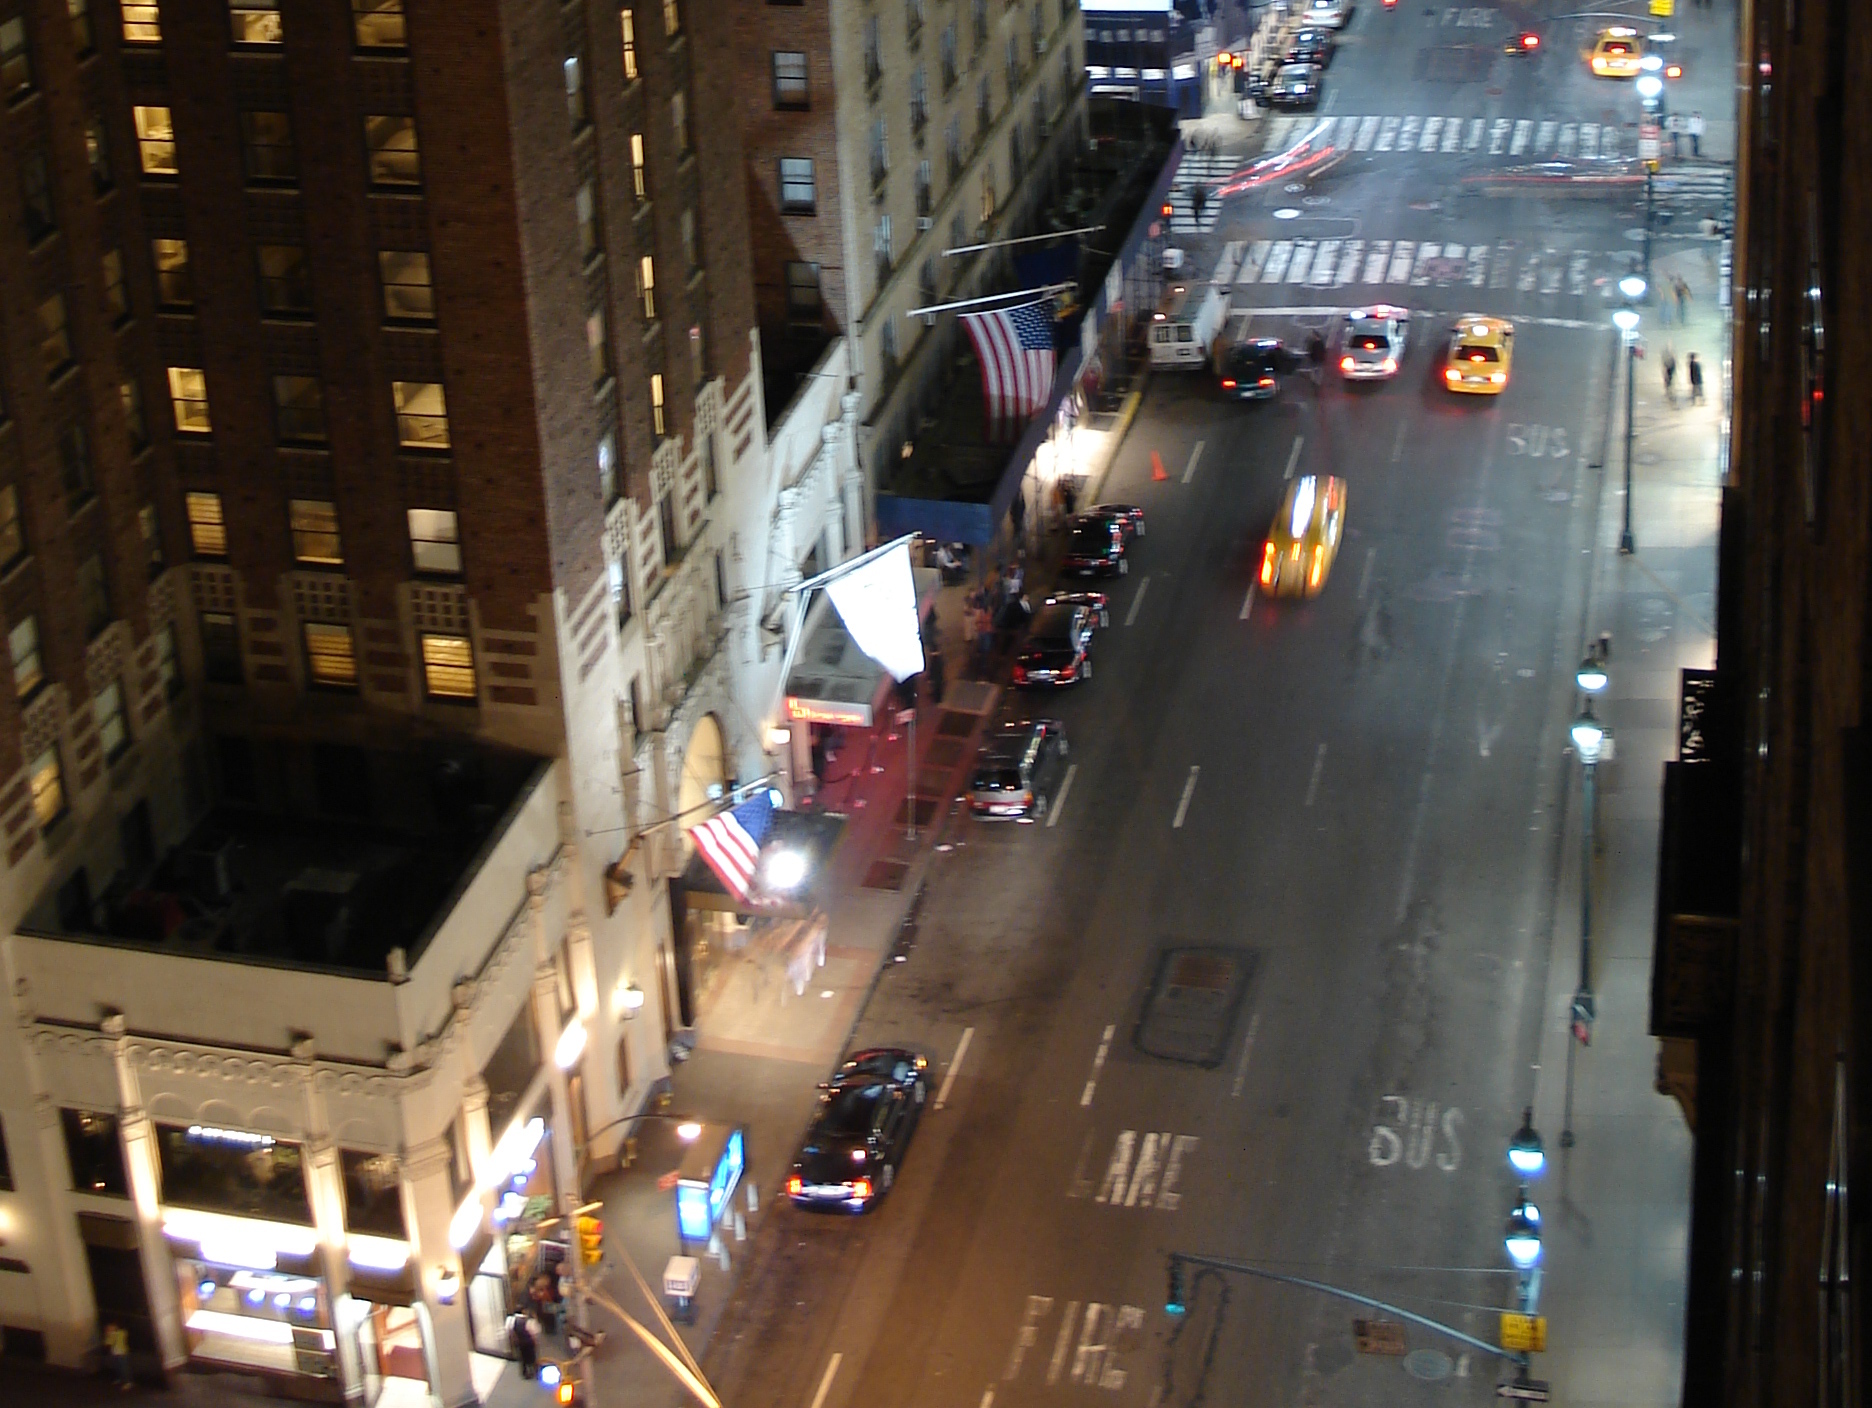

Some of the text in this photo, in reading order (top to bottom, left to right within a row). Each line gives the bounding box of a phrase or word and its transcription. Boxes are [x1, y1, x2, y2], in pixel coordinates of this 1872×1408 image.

[1507, 423, 1571, 458] BUS
[1066, 1130, 1200, 1210] LANE
[1369, 1095, 1465, 1171] BUS
[1002, 1295, 1146, 1390] FIRE
